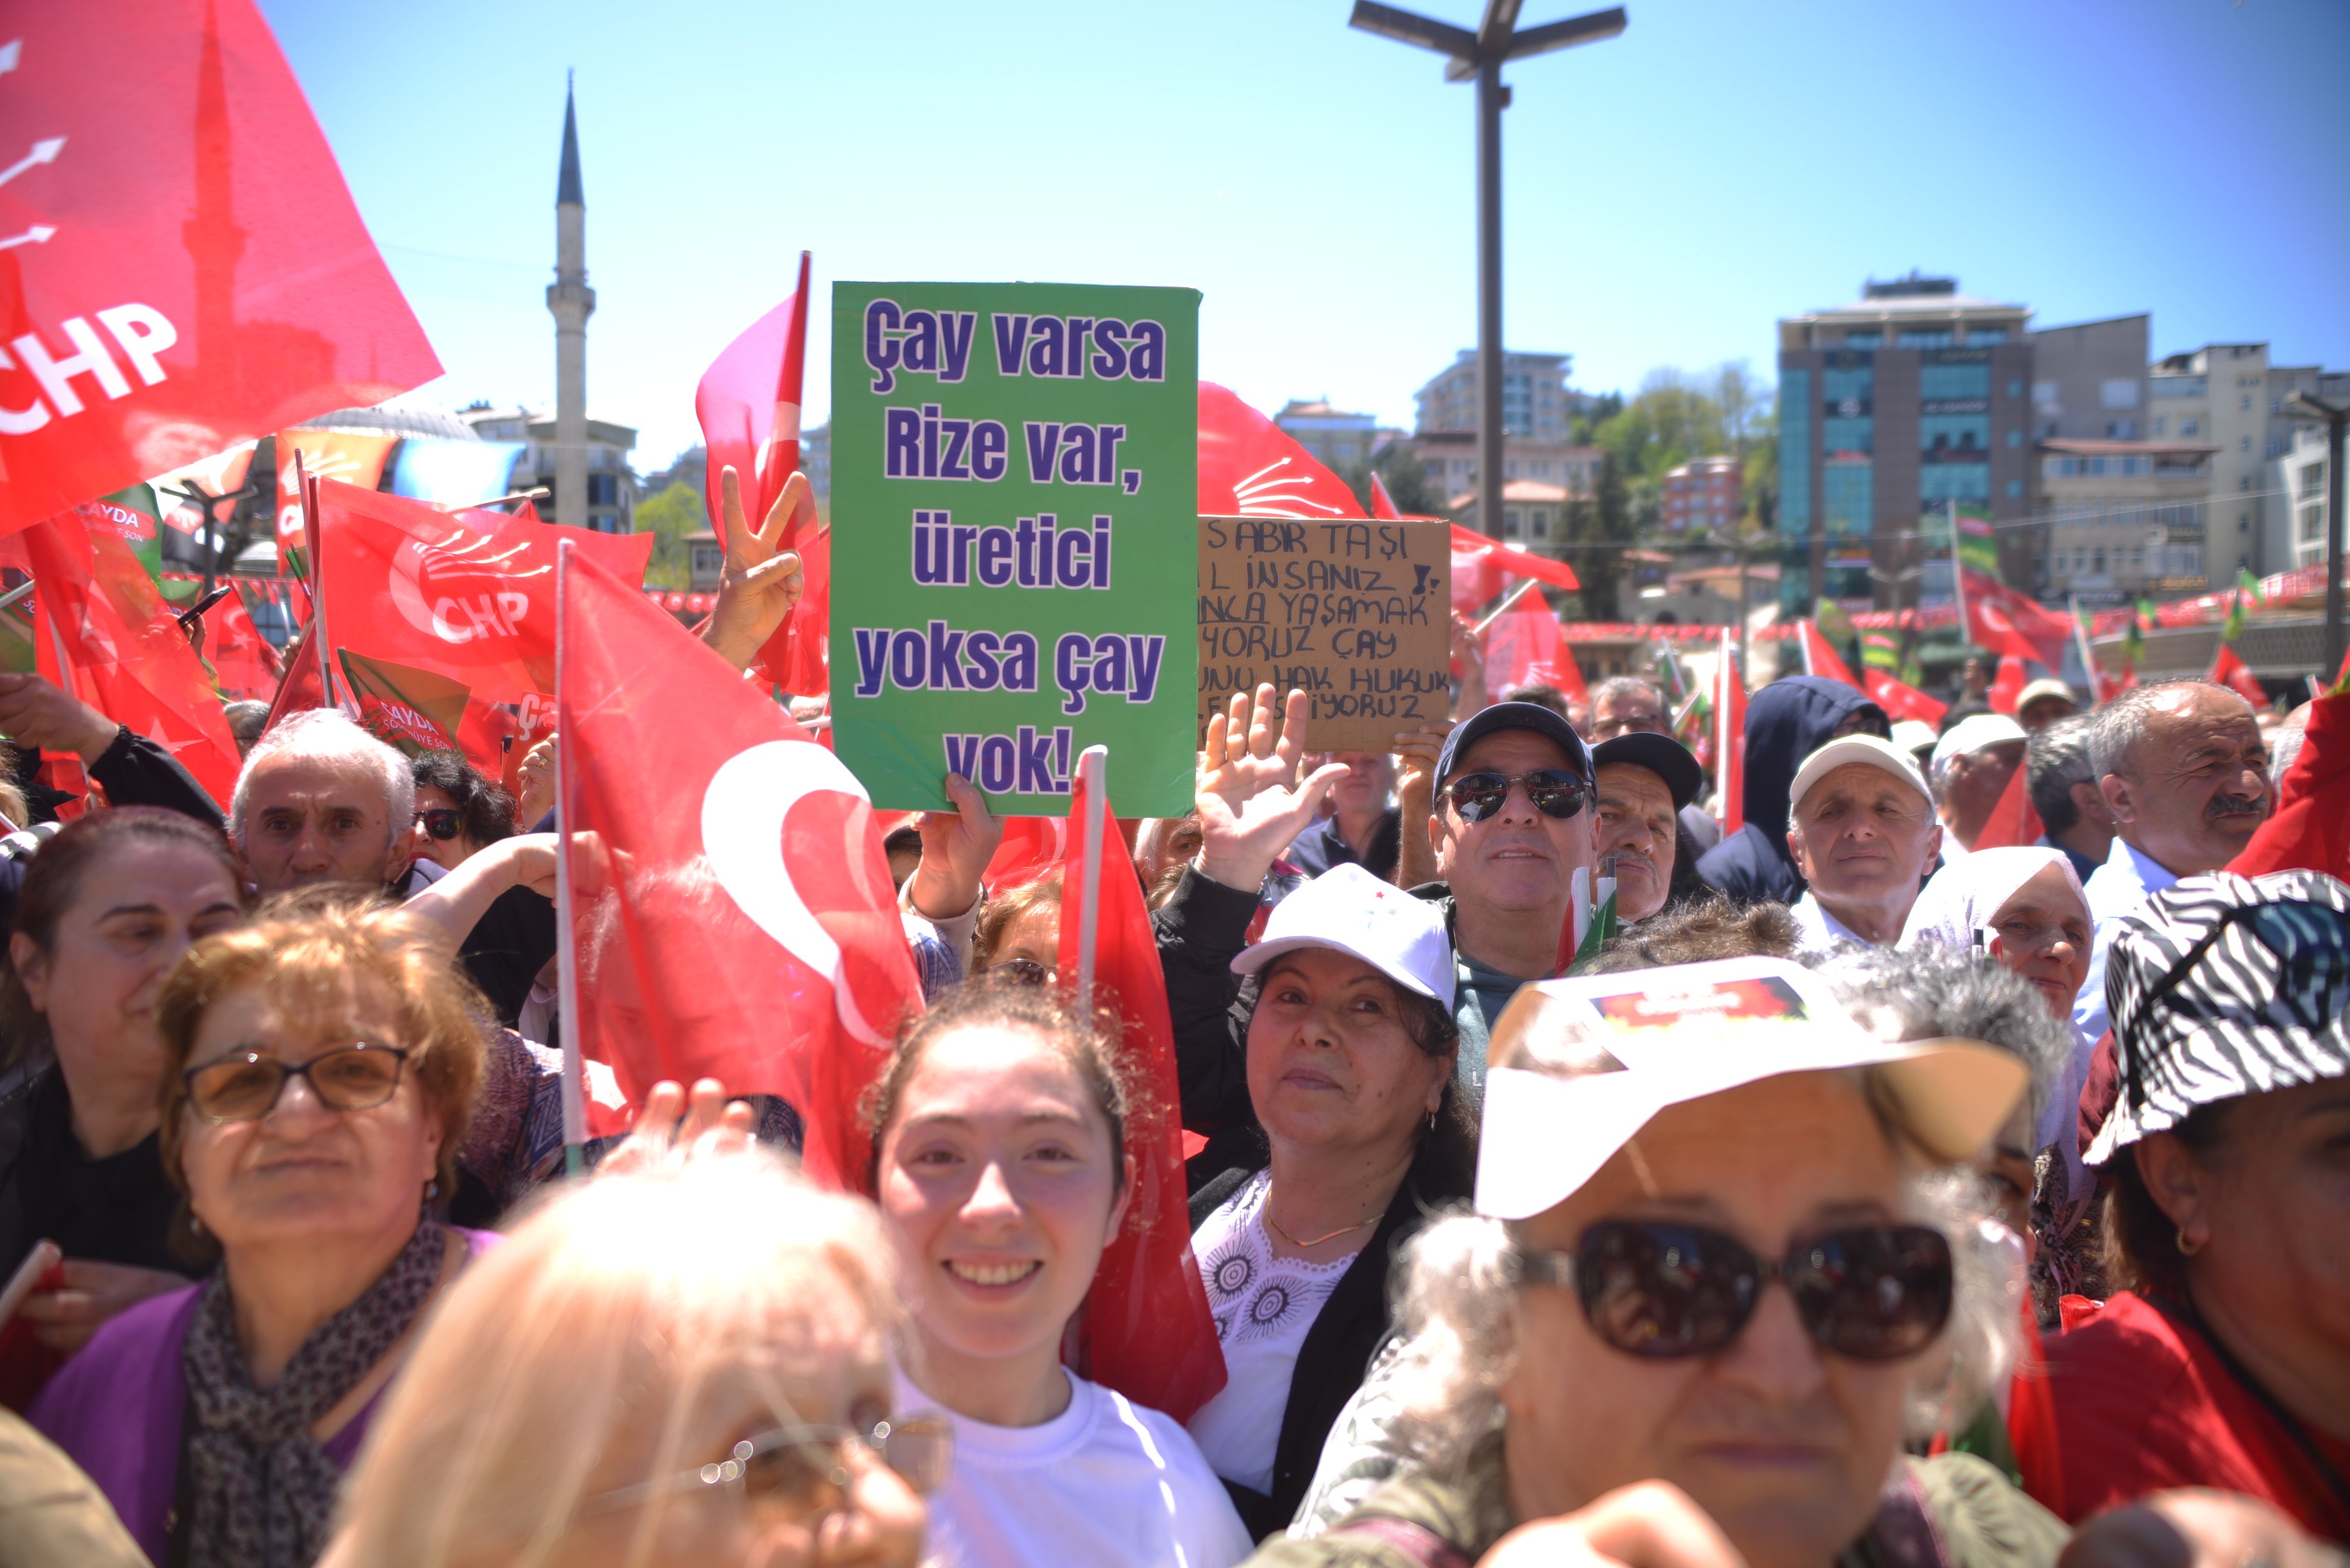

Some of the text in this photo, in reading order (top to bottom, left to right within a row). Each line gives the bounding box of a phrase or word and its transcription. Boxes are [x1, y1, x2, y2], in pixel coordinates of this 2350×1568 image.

[863, 298, 1166, 395] Çay varsa
[884, 402, 1142, 495] Rize var,
[911, 509, 1112, 590] üretici
[1321, 524, 1408, 561] TAŞI
[1247, 555, 1397, 591] İNSANIZ
[432, 592, 529, 644] CHP
[1198, 592, 1428, 627] NCA YAŞAMAK
[1332, 628, 1397, 660] ÇAY
[852, 620, 1166, 716] yoksa çay
[1273, 665, 1333, 692] HAK
[1350, 668, 1450, 693] HUKUK
